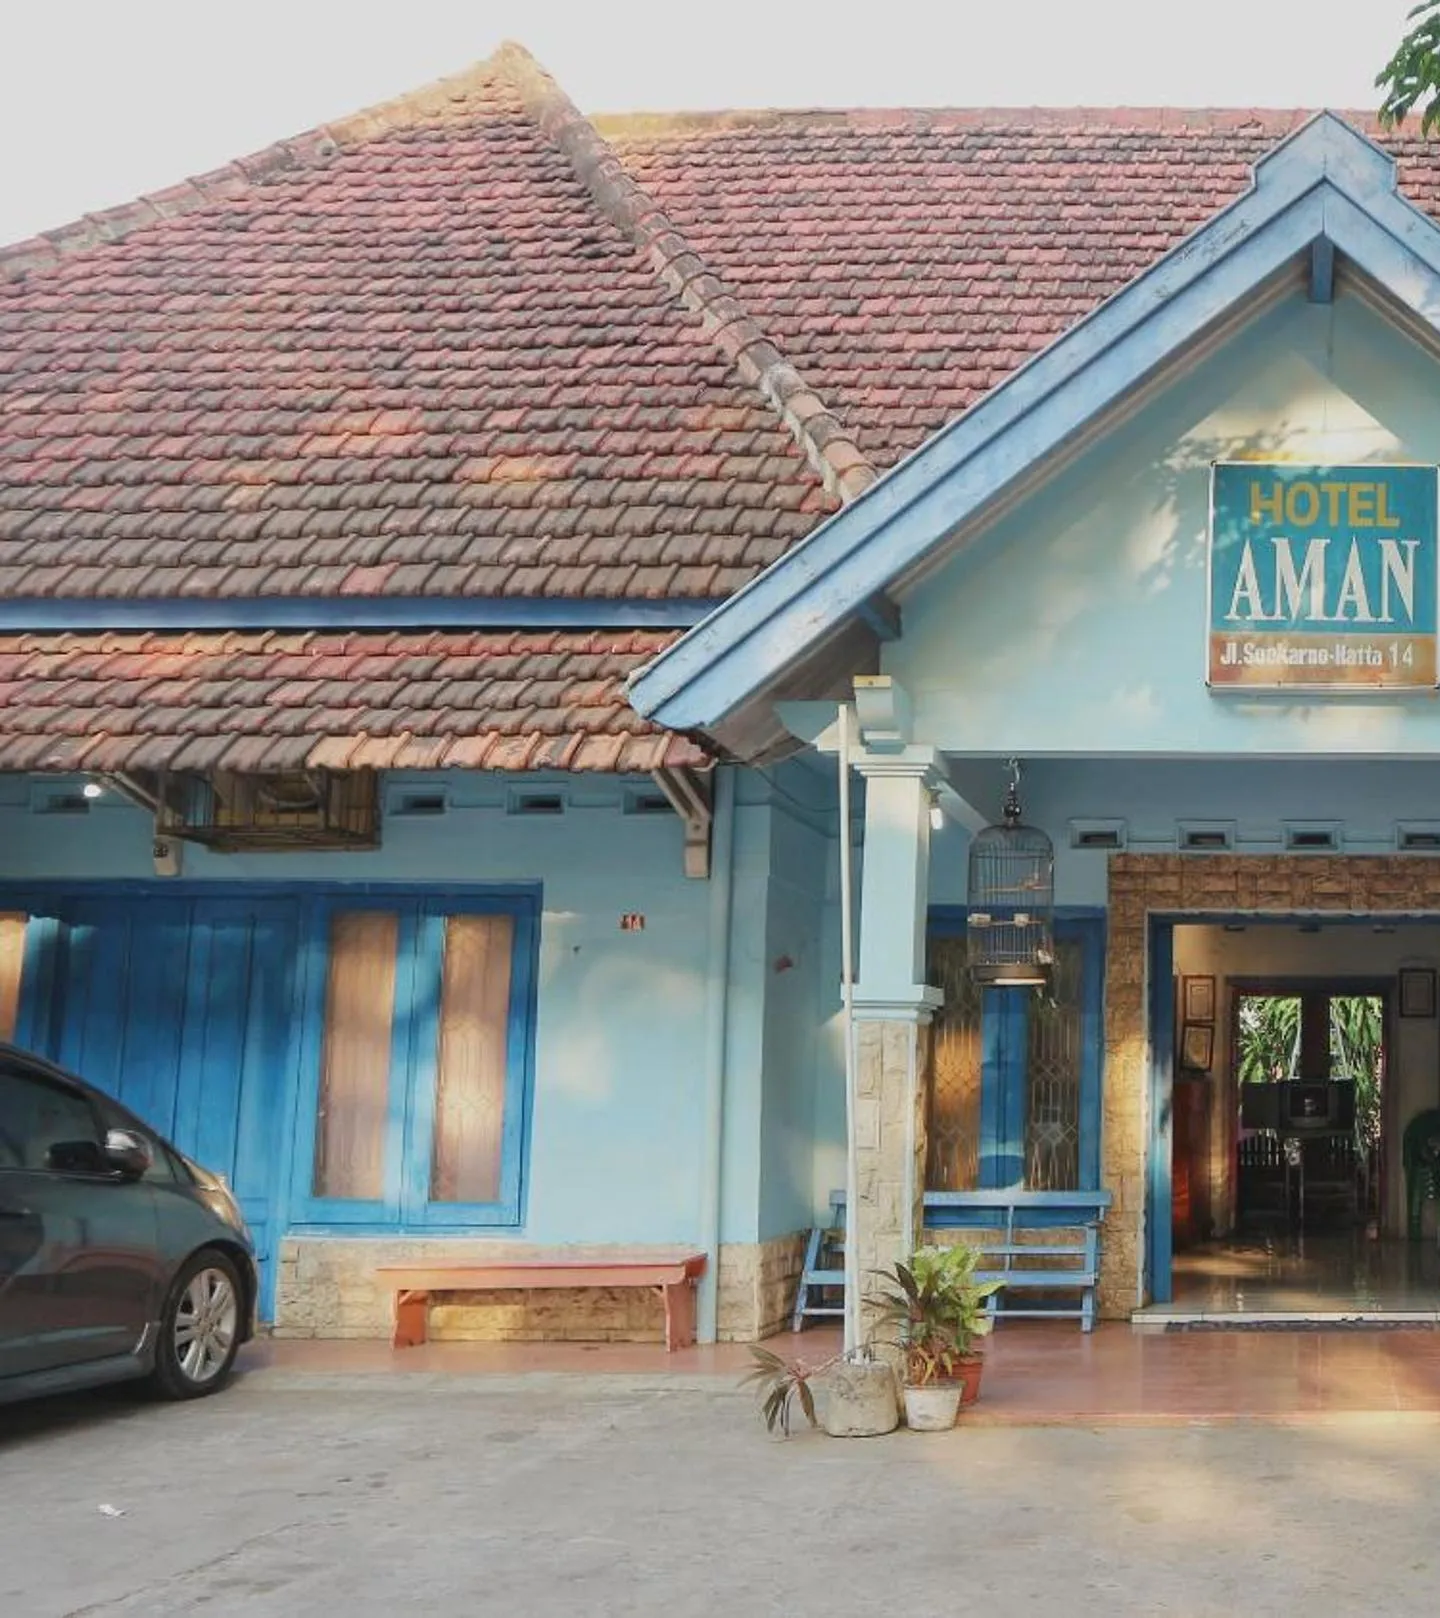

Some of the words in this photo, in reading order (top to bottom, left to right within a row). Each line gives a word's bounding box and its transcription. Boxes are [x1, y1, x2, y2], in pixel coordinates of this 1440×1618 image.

[1250, 480, 1400, 528] HOTEL
[1224, 536, 1421, 625] AMAN
[1389, 642, 1413, 667] 14
